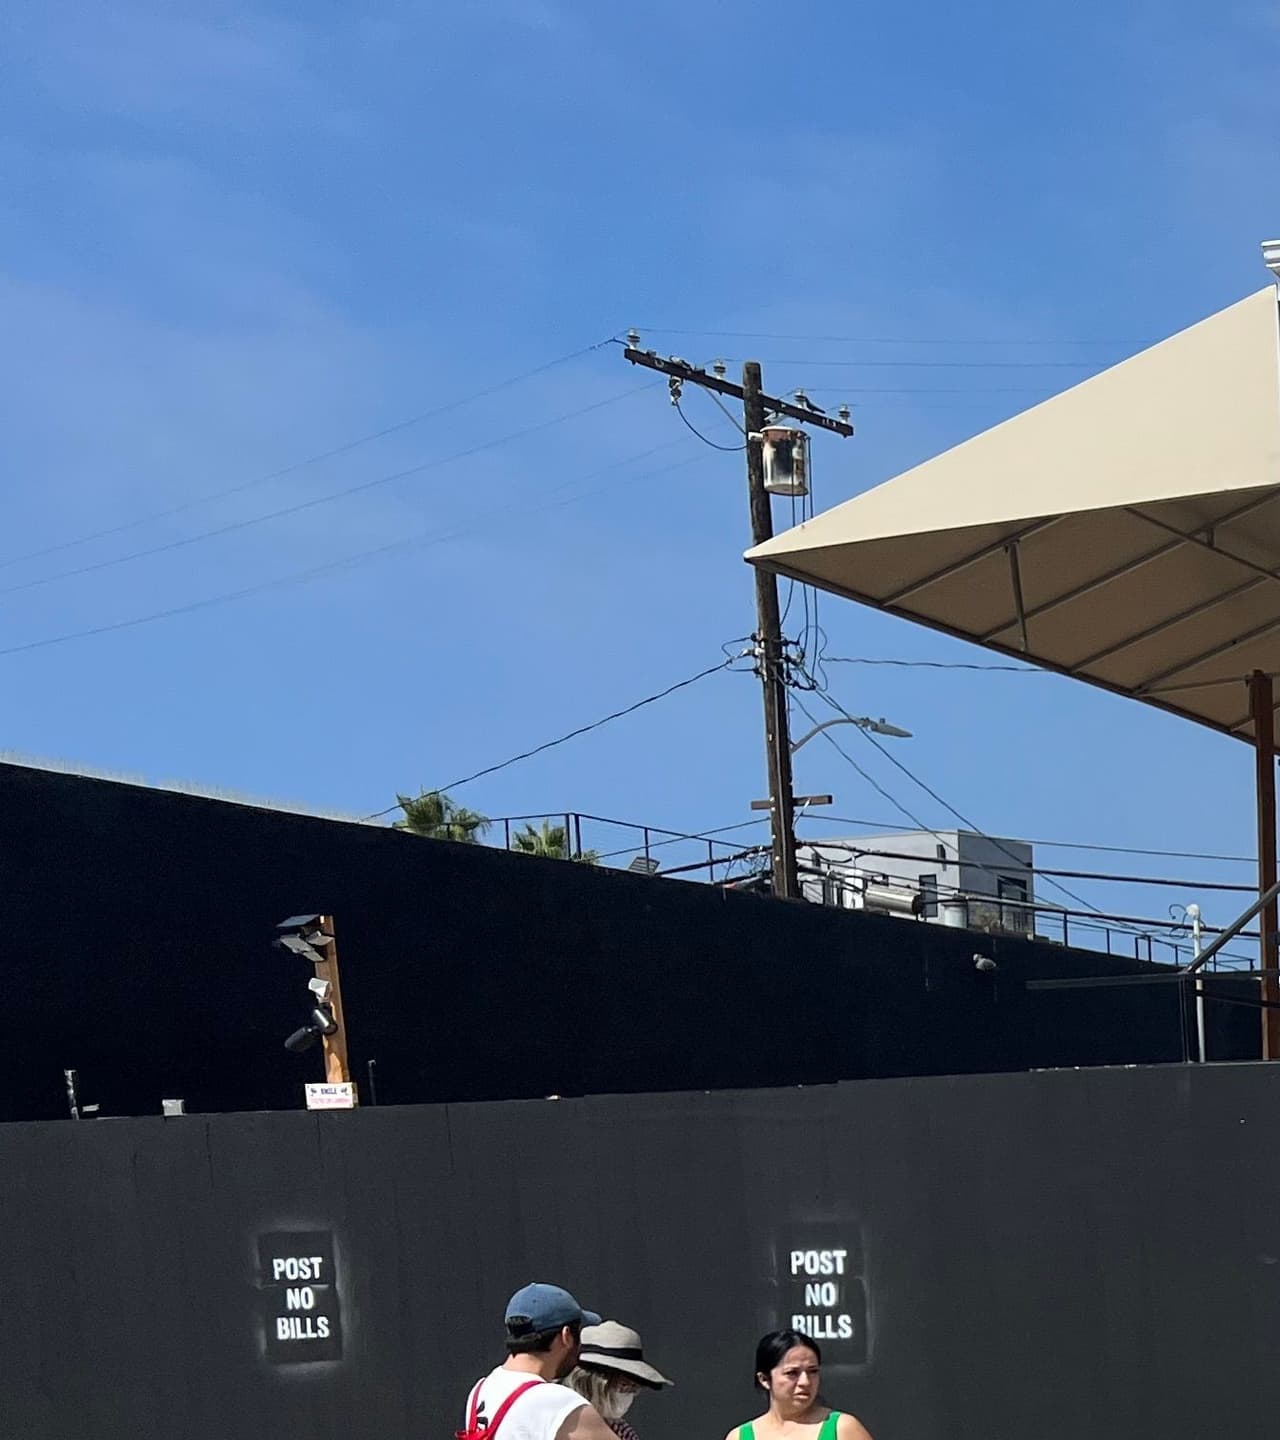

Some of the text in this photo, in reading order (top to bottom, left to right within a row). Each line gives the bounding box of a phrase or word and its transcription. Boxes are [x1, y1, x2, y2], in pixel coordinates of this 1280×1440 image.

[272, 1257, 323, 1280] POST
[790, 1249, 848, 1275] POST
[286, 1286, 314, 1310] NO
[805, 1281, 836, 1307] NO
[276, 1316, 330, 1340] BILLS
